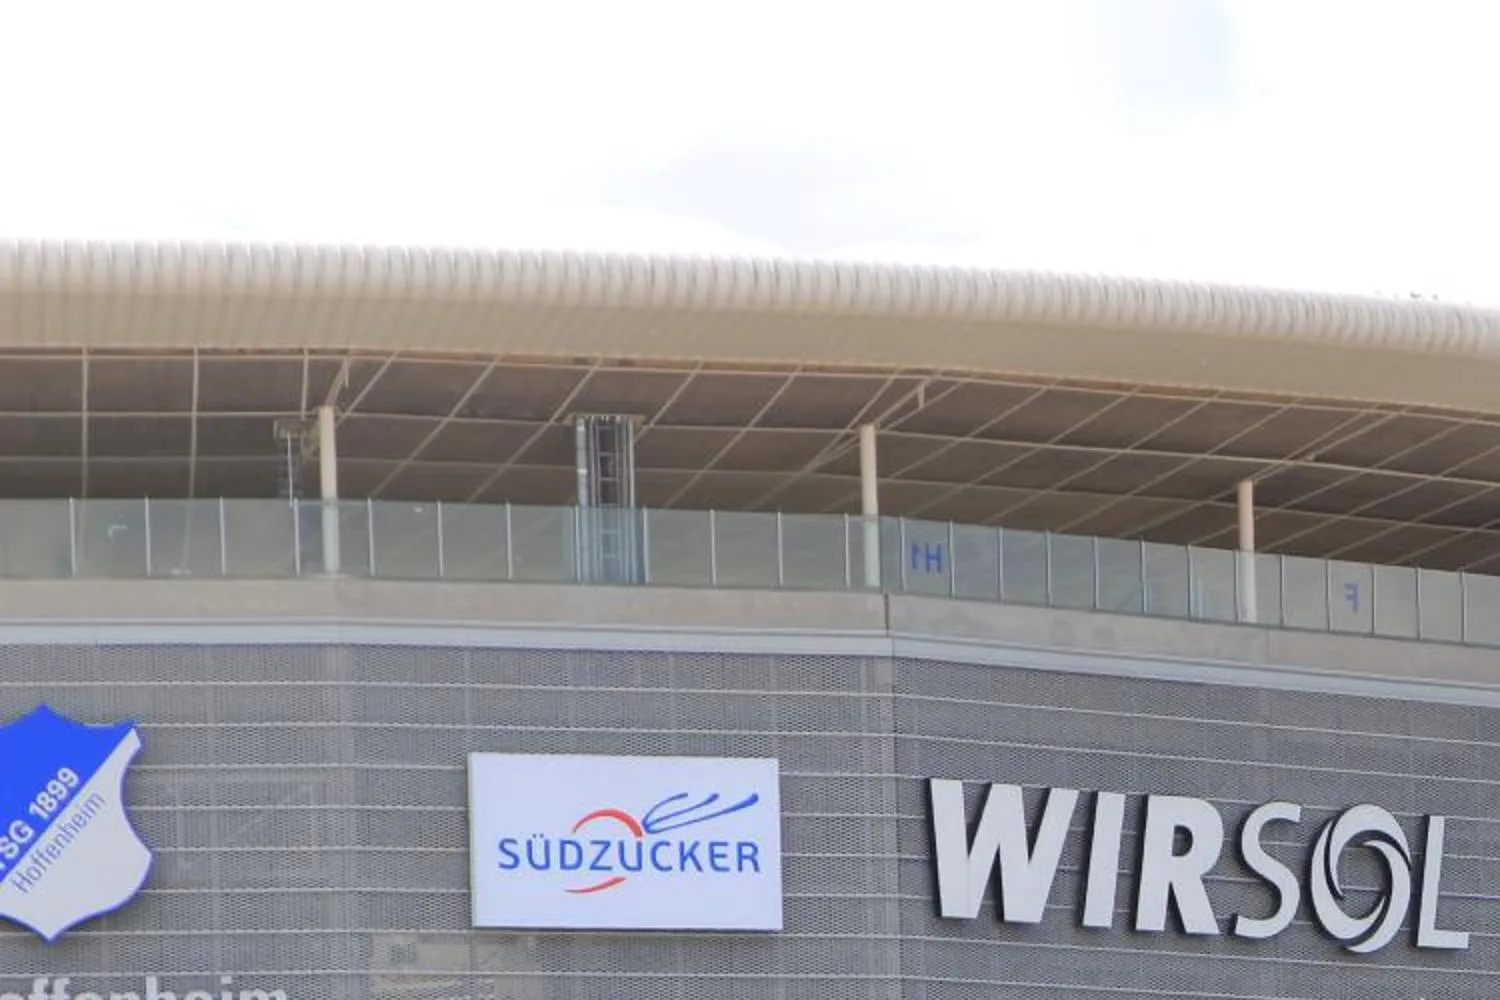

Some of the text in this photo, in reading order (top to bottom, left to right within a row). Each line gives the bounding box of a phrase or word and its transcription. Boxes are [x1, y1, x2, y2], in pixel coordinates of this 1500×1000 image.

[0, 767, 80, 873] SG 1899
[12, 791, 105, 893] Hoffenheim
[498, 833, 761, 872] SÜDZUCKER
[929, 777, 1470, 953] WIRSOL
